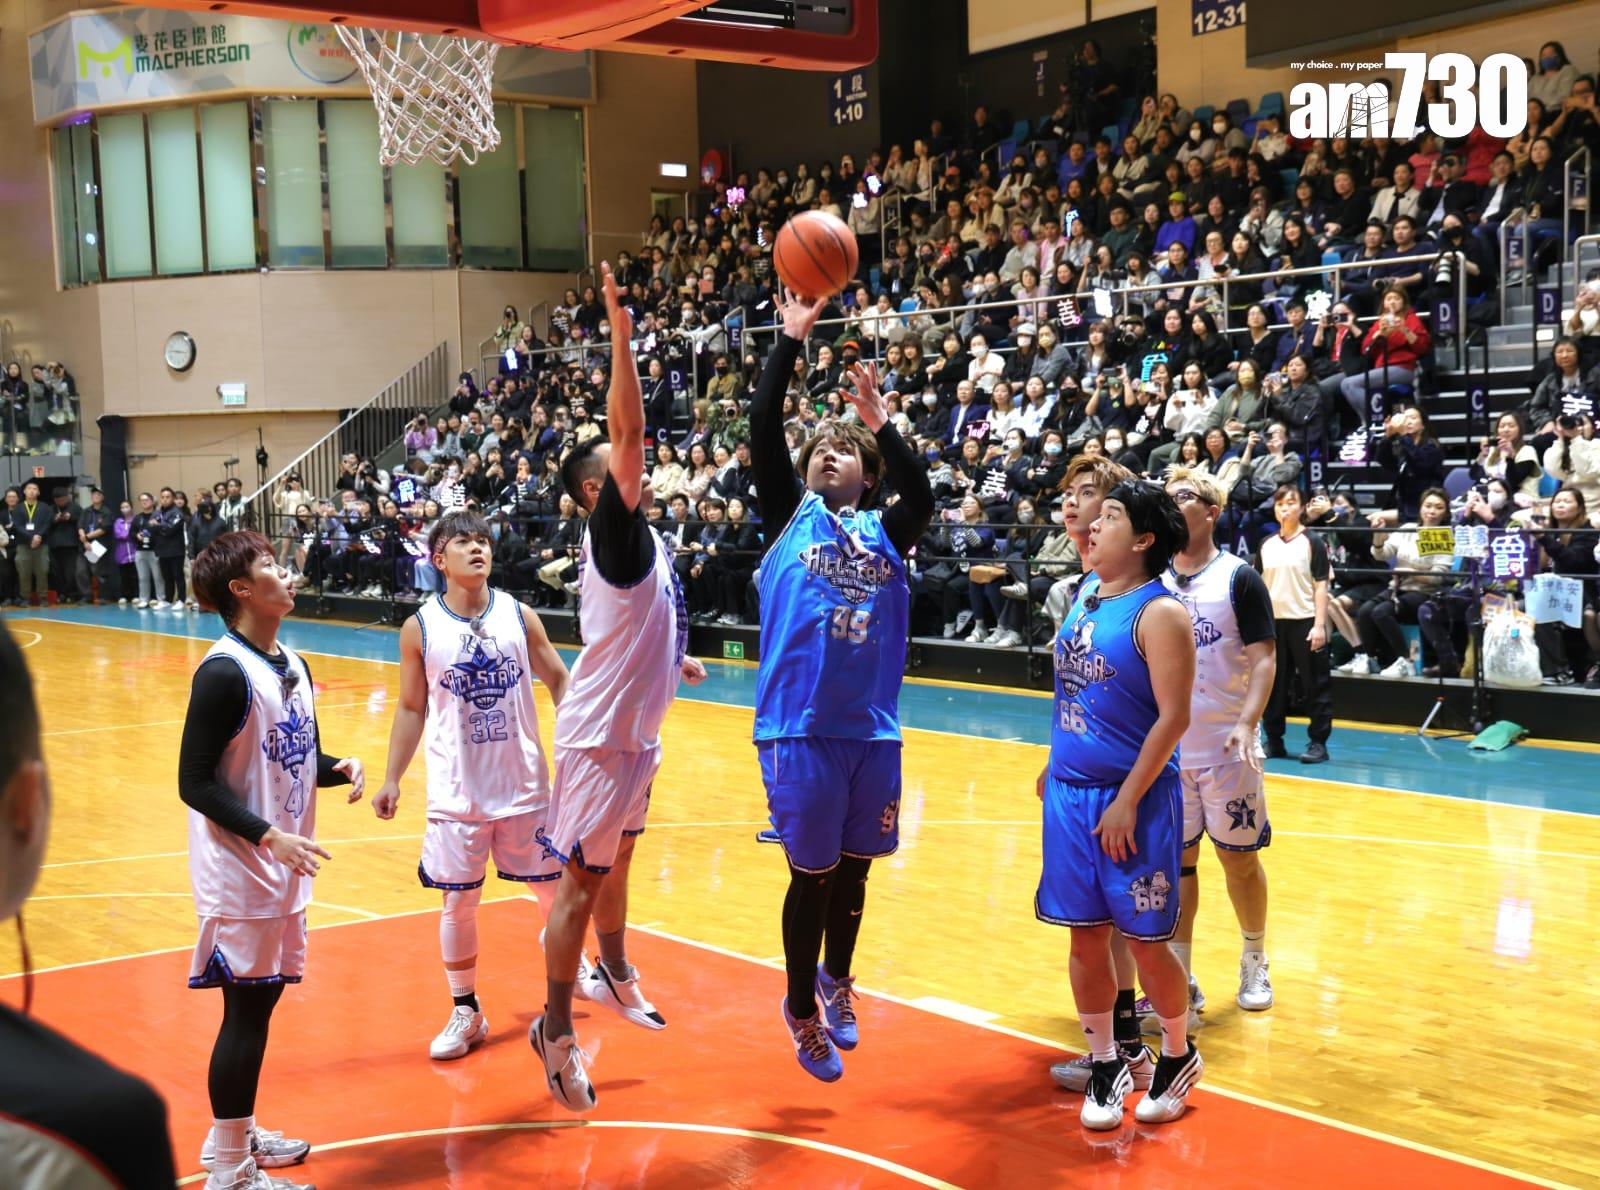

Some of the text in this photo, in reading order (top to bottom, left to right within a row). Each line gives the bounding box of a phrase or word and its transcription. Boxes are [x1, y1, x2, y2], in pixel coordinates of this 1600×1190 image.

[1194, 2, 1247, 33] 12-31
[135, 44, 250, 73] MACPHERSON
[833, 78, 842, 99] 1
[833, 102, 864, 125] 1-10
[1509, 240, 1519, 259] E
[1439, 302, 1451, 322] D
[1543, 292, 1554, 313] D
[731, 328, 740, 341] E
[670, 370, 681, 384] D
[1471, 389, 1484, 411] C
[657, 428, 667, 442] C
[1310, 461, 1322, 482] B
[1236, 535, 1249, 556] A
[476, 660, 519, 688] STAR
[469, 709, 508, 744] 32
[1060, 699, 1088, 735] 66
[284, 779, 304, 819] 4
